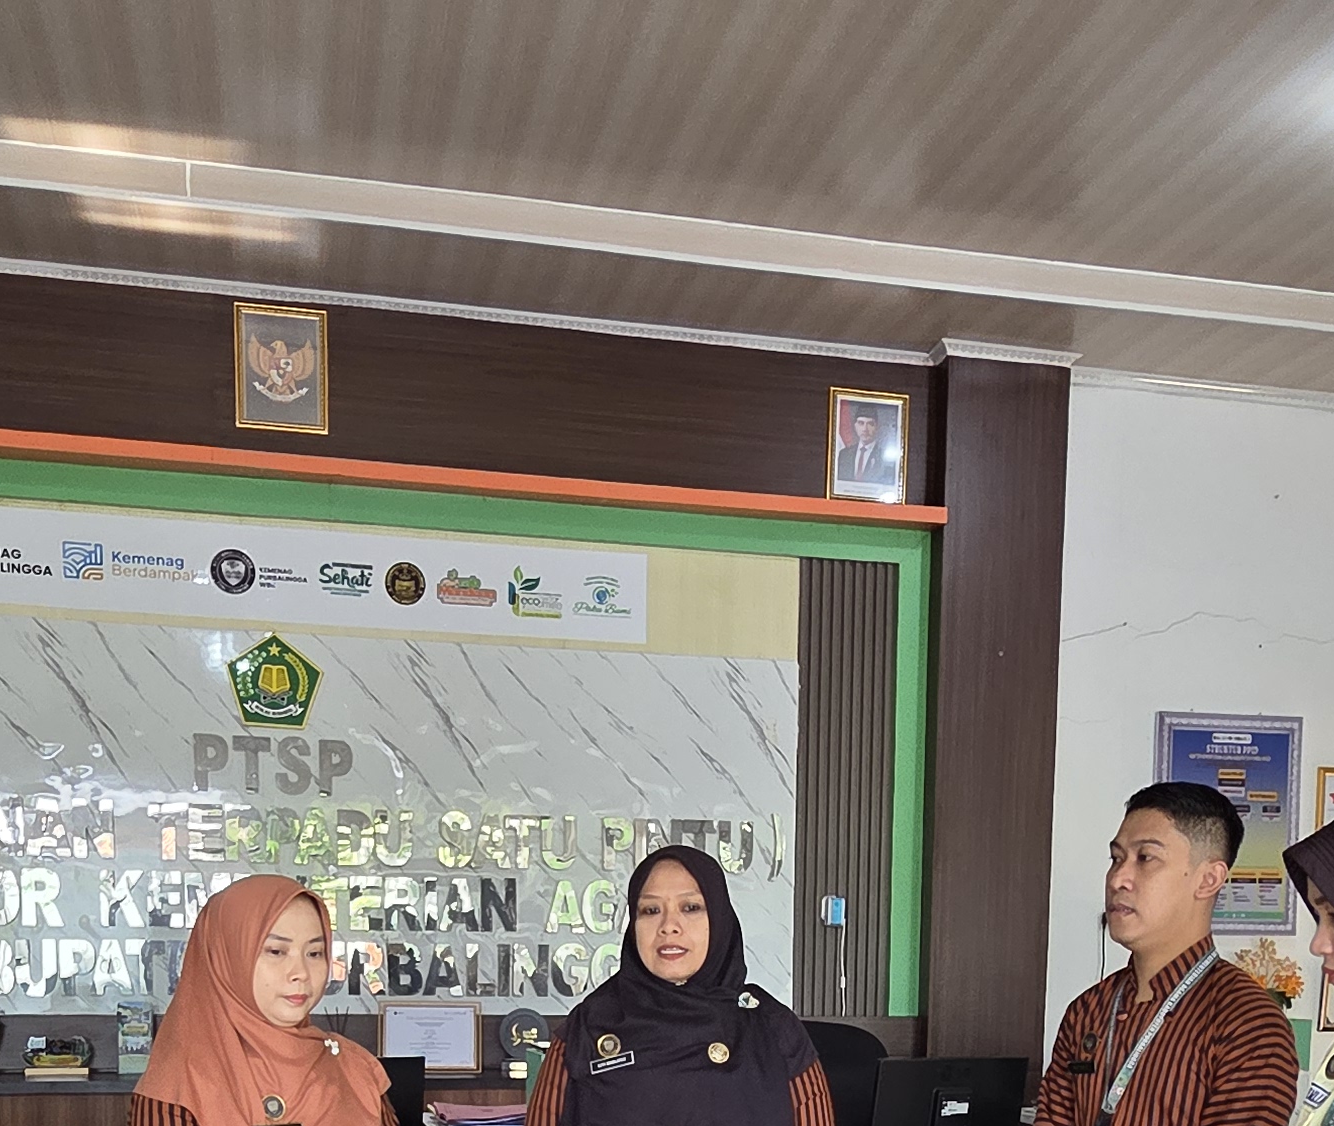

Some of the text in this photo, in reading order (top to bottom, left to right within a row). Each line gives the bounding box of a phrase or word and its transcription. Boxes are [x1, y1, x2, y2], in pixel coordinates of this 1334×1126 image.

[111, 551, 185, 570] Kemenag
[259, 566, 293, 576] KEMENAG
[259, 575, 308, 584] PURBALINGGA
[319, 563, 373, 588] Sehati
[193, 733, 353, 796] PTSP
[147, 801, 414, 867] TERPADU
[438, 809, 576, 870] SATU
